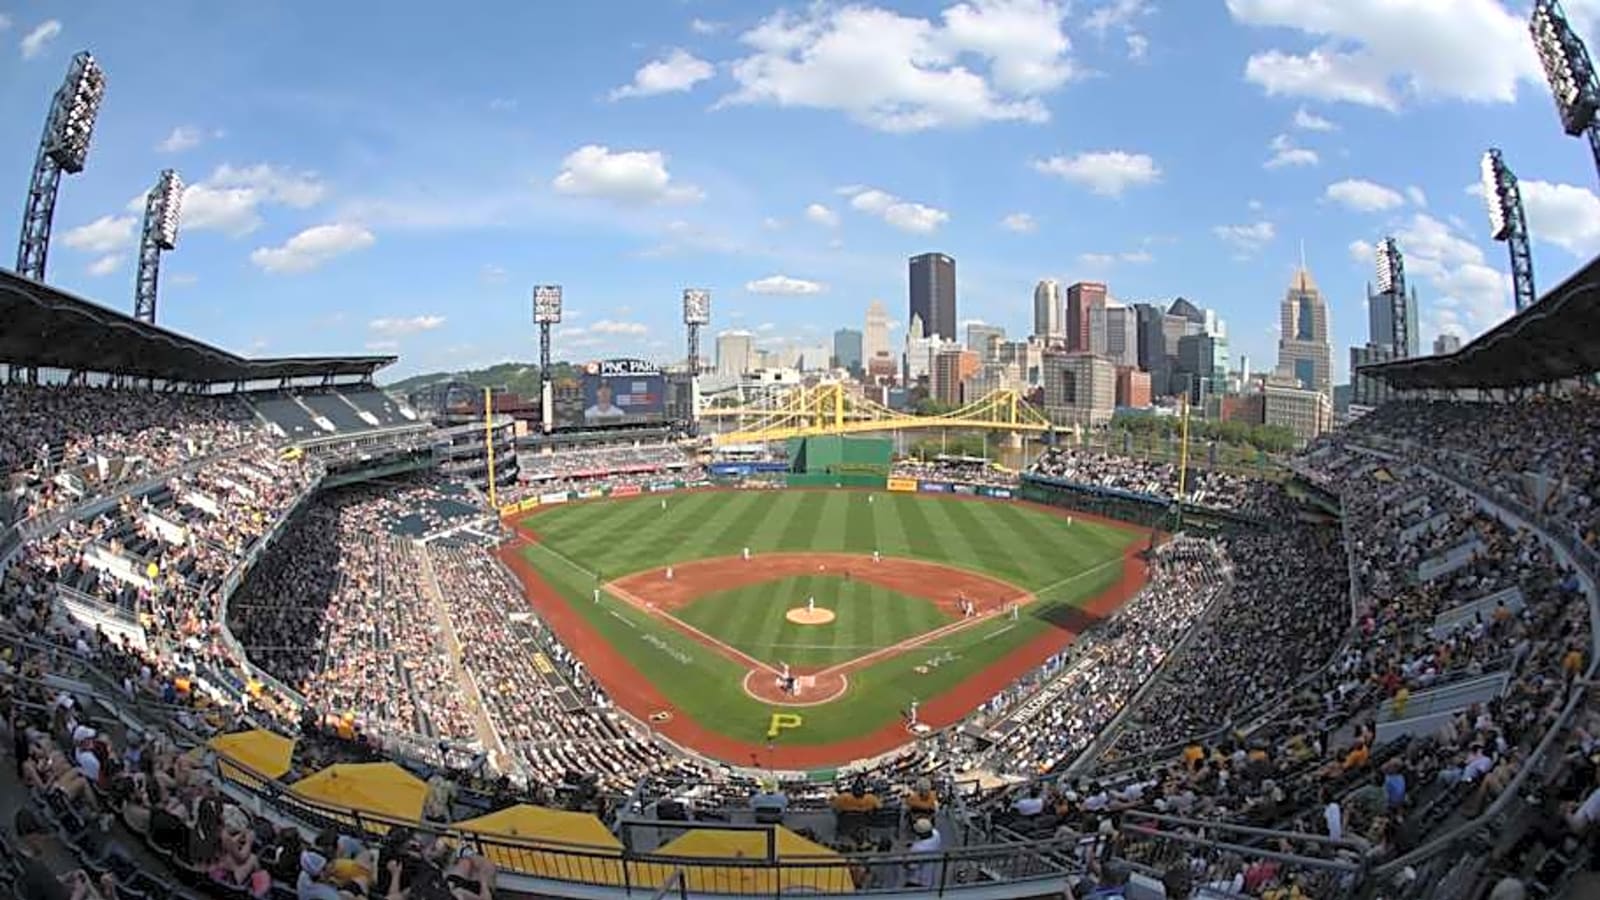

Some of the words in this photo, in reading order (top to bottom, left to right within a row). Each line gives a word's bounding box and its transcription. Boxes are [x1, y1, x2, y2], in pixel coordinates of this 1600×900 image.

[601, 361, 627, 373] PNC
[630, 361, 659, 373] PARK
[767, 713, 802, 736] P
